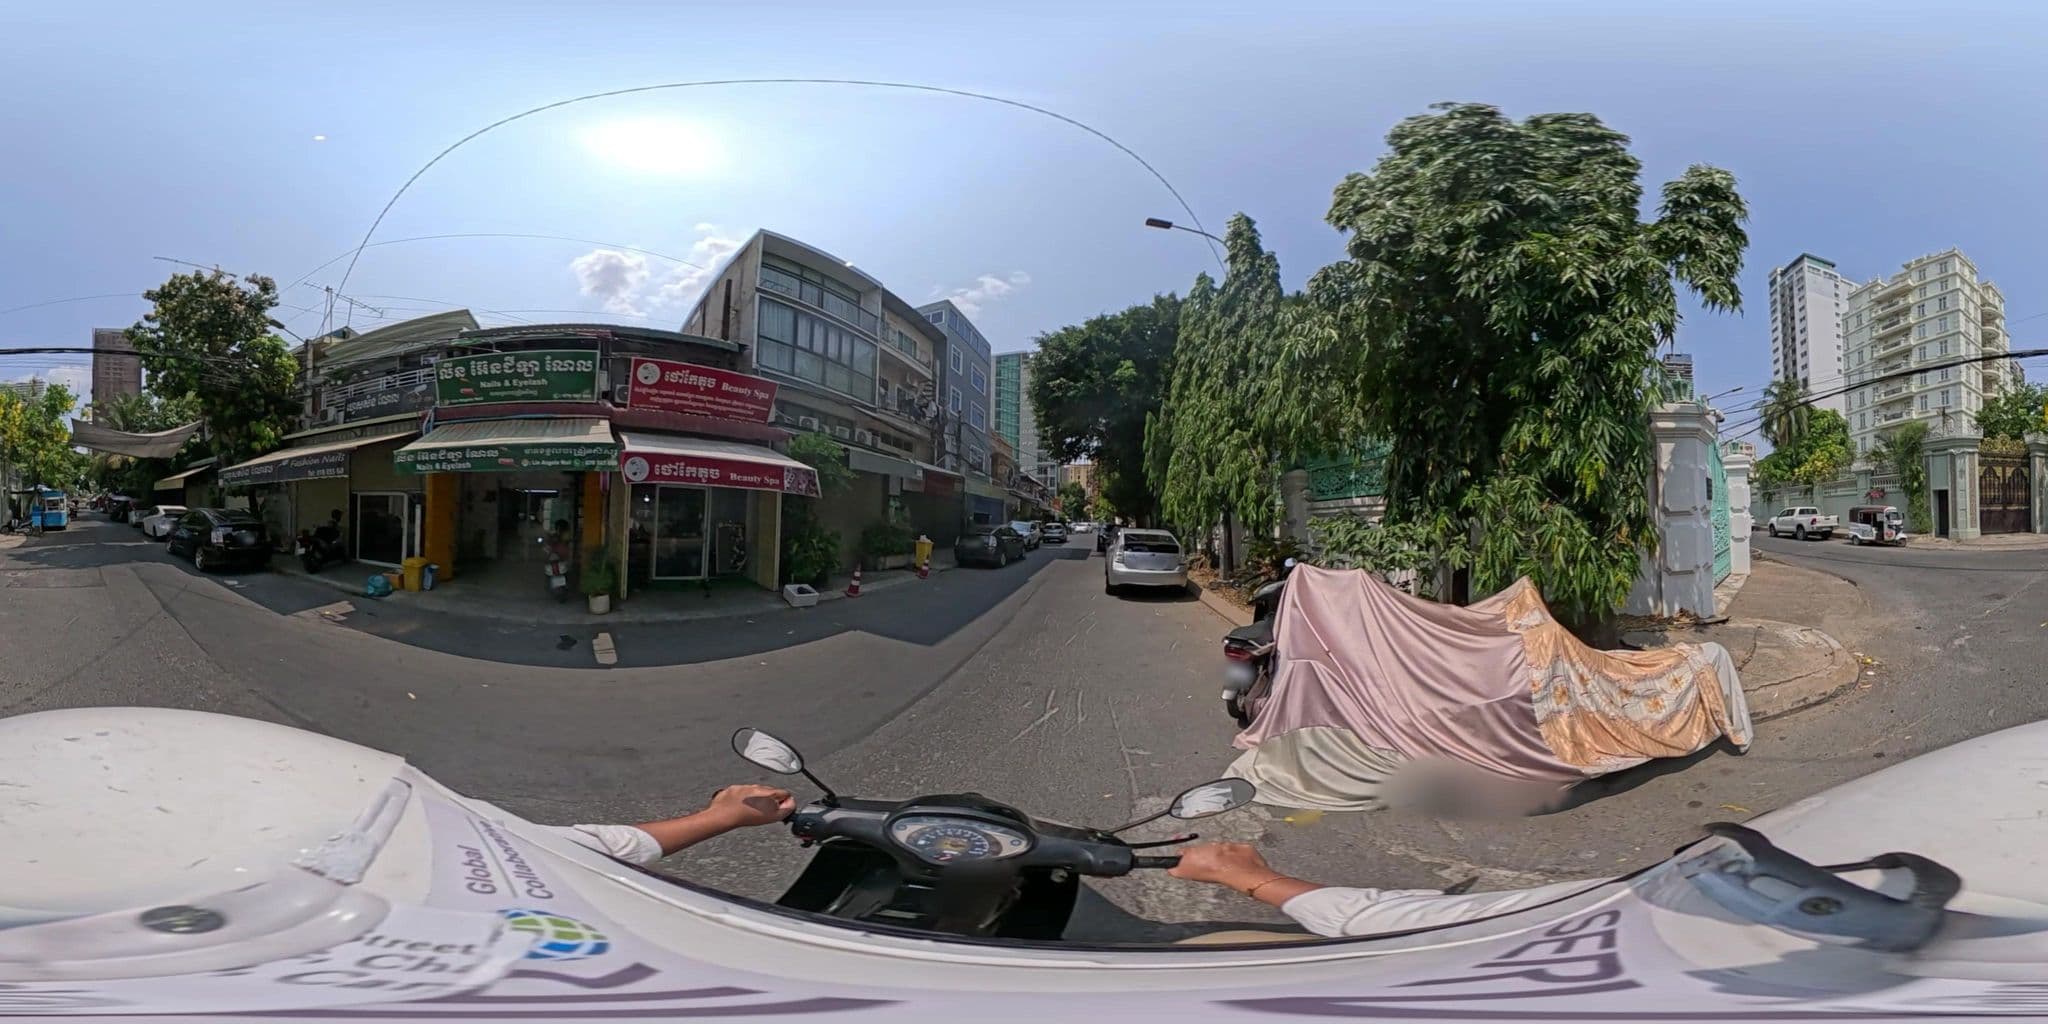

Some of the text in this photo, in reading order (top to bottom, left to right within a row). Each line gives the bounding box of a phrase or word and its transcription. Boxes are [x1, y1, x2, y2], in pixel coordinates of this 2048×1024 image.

[480, 381, 501, 389] Nails
[512, 379, 548, 388] Eyelash
[721, 382, 752, 397] Beauty
[754, 388, 769, 400] Spa
[289, 453, 345, 469] Fashion Nails
[416, 463, 432, 471] Nails
[441, 461, 472, 471] Eyelash
[730, 472, 780, 486] Beauty Spa
[457, 844, 498, 895] Global
